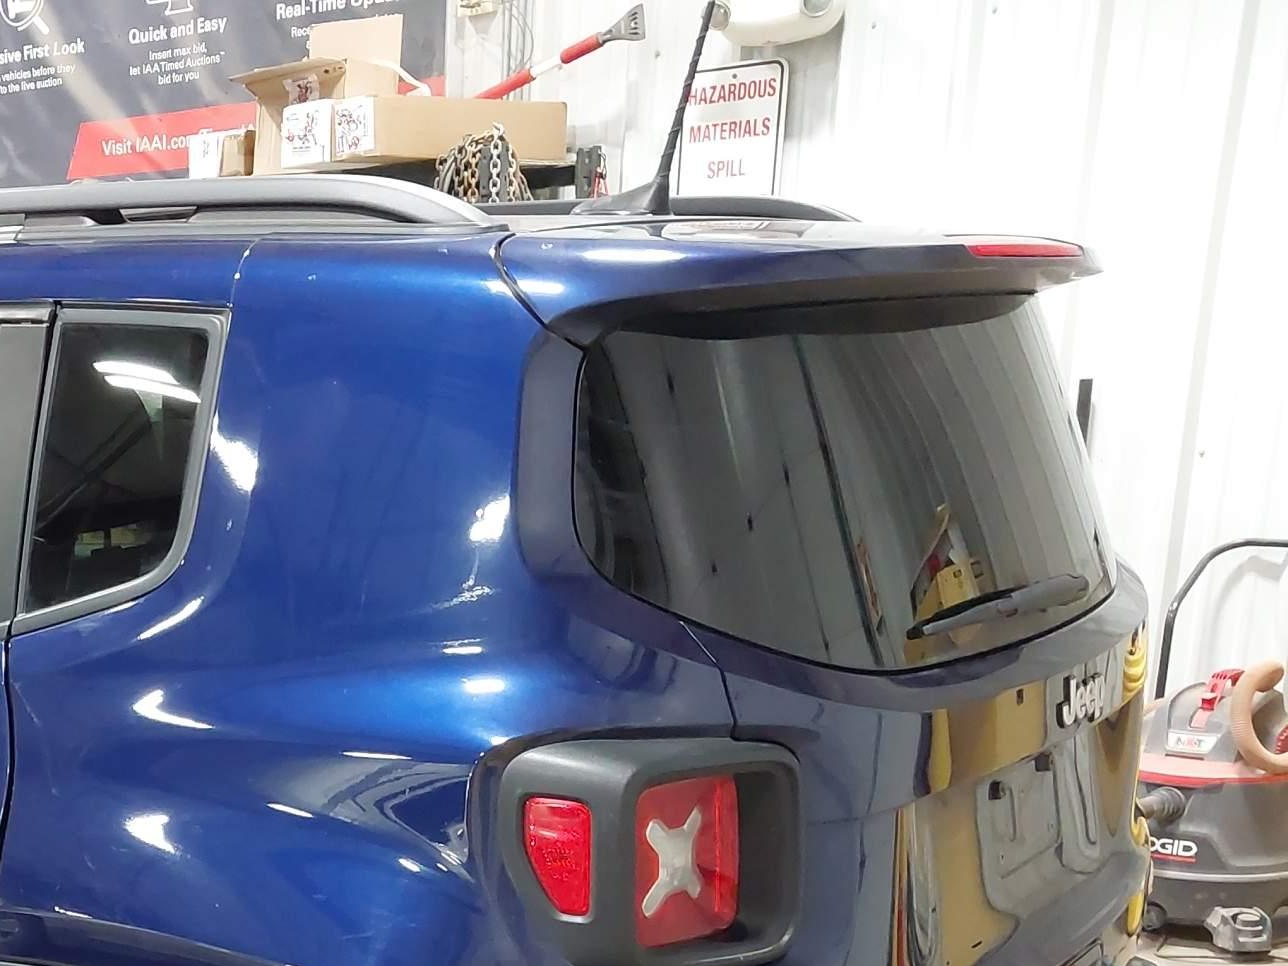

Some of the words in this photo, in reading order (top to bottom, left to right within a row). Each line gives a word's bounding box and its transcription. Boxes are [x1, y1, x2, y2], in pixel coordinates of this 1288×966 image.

[129, 24, 168, 45] Quick
[170, 19, 194, 39] and
[197, 16, 228, 34] Easy
[23, 43, 50, 61] First
[53, 37, 85, 57] Look
[149, 48, 172, 61] Insert
[173, 47, 192, 57] max
[192, 42, 207, 55] bid,
[2, 69, 32, 82] vehicles
[32, 65, 56, 77] before
[56, 63, 77, 75] they
[129, 65, 141, 76] let
[142, 62, 160, 74] IAA
[160, 58, 185, 73] Timed
[0, 84, 8, 95] to
[8, 82, 20, 93] the
[21, 79, 36, 92] live
[35, 76, 63, 90] auction
[158, 71, 172, 86] bid
[172, 71, 184, 84] for
[184, 70, 200, 83] you
[688, 78, 777, 107] HAZARDOUS
[689, 117, 771, 144] MATERIALS
[102, 138, 133, 156] Visit
[135, 134, 191, 153] IAAI.co
[706, 158, 746, 179] SPILL
[1060, 675, 1103, 726] Jeep
